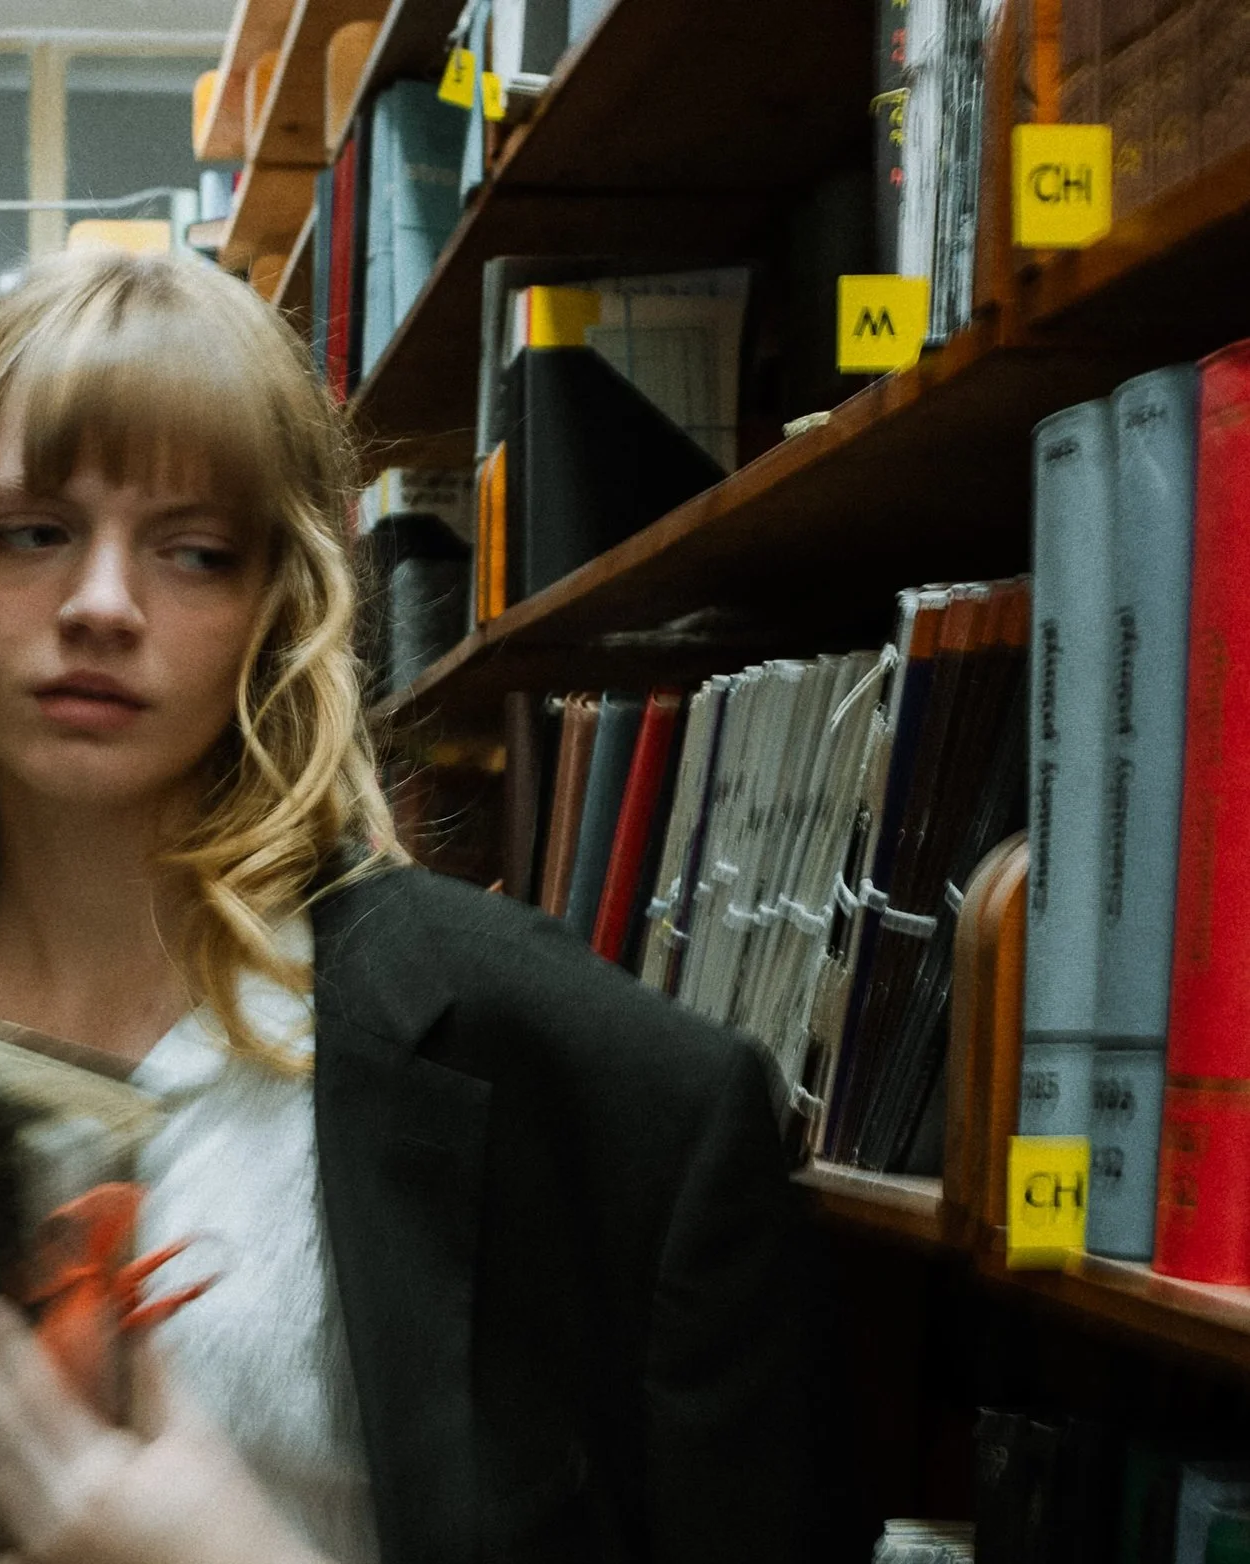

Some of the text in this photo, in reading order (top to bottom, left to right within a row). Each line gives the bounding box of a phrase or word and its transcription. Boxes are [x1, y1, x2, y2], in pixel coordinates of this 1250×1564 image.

[1031, 163, 1092, 205] CH
[853, 305, 896, 338] M
[1025, 1171, 1084, 1208] CH
